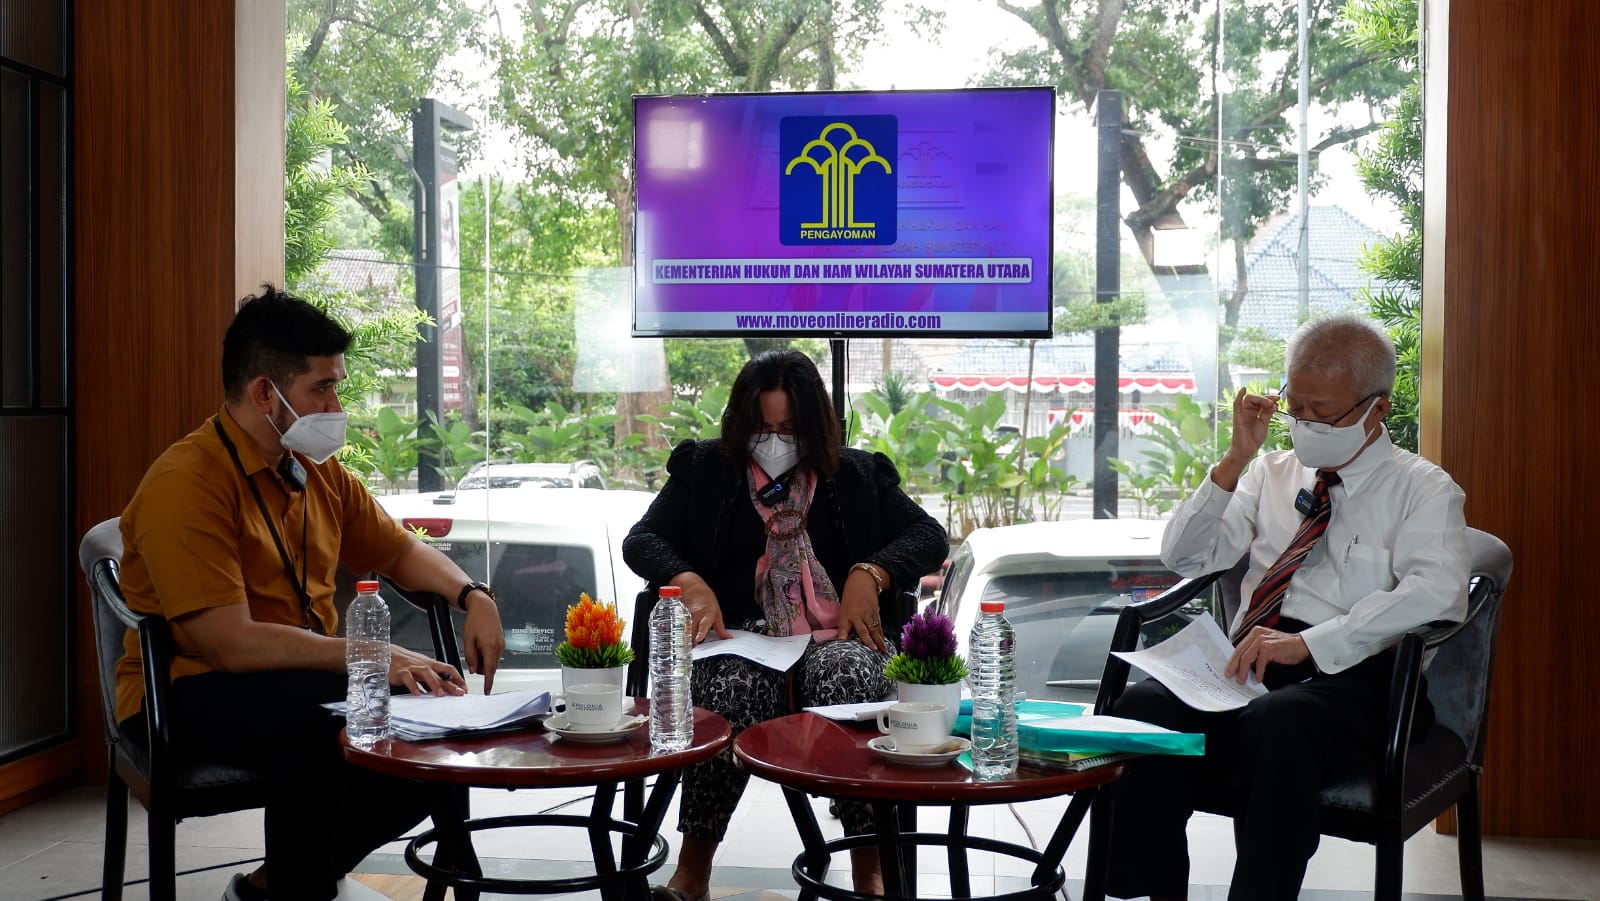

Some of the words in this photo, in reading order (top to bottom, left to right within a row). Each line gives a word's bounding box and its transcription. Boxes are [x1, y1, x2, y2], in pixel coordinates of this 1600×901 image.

[801, 230, 876, 239] PENGAYOMAN
[655, 265, 741, 279] KEMENTERIAN
[744, 264, 791, 279] HUKUM
[794, 264, 820, 278] DAN
[823, 264, 852, 278] HAM
[855, 264, 912, 278] WILAYAH
[915, 264, 985, 278] SUMATERA
[988, 264, 1031, 278] UTARA
[736, 312, 941, 329] www.moveonlineradio.com
